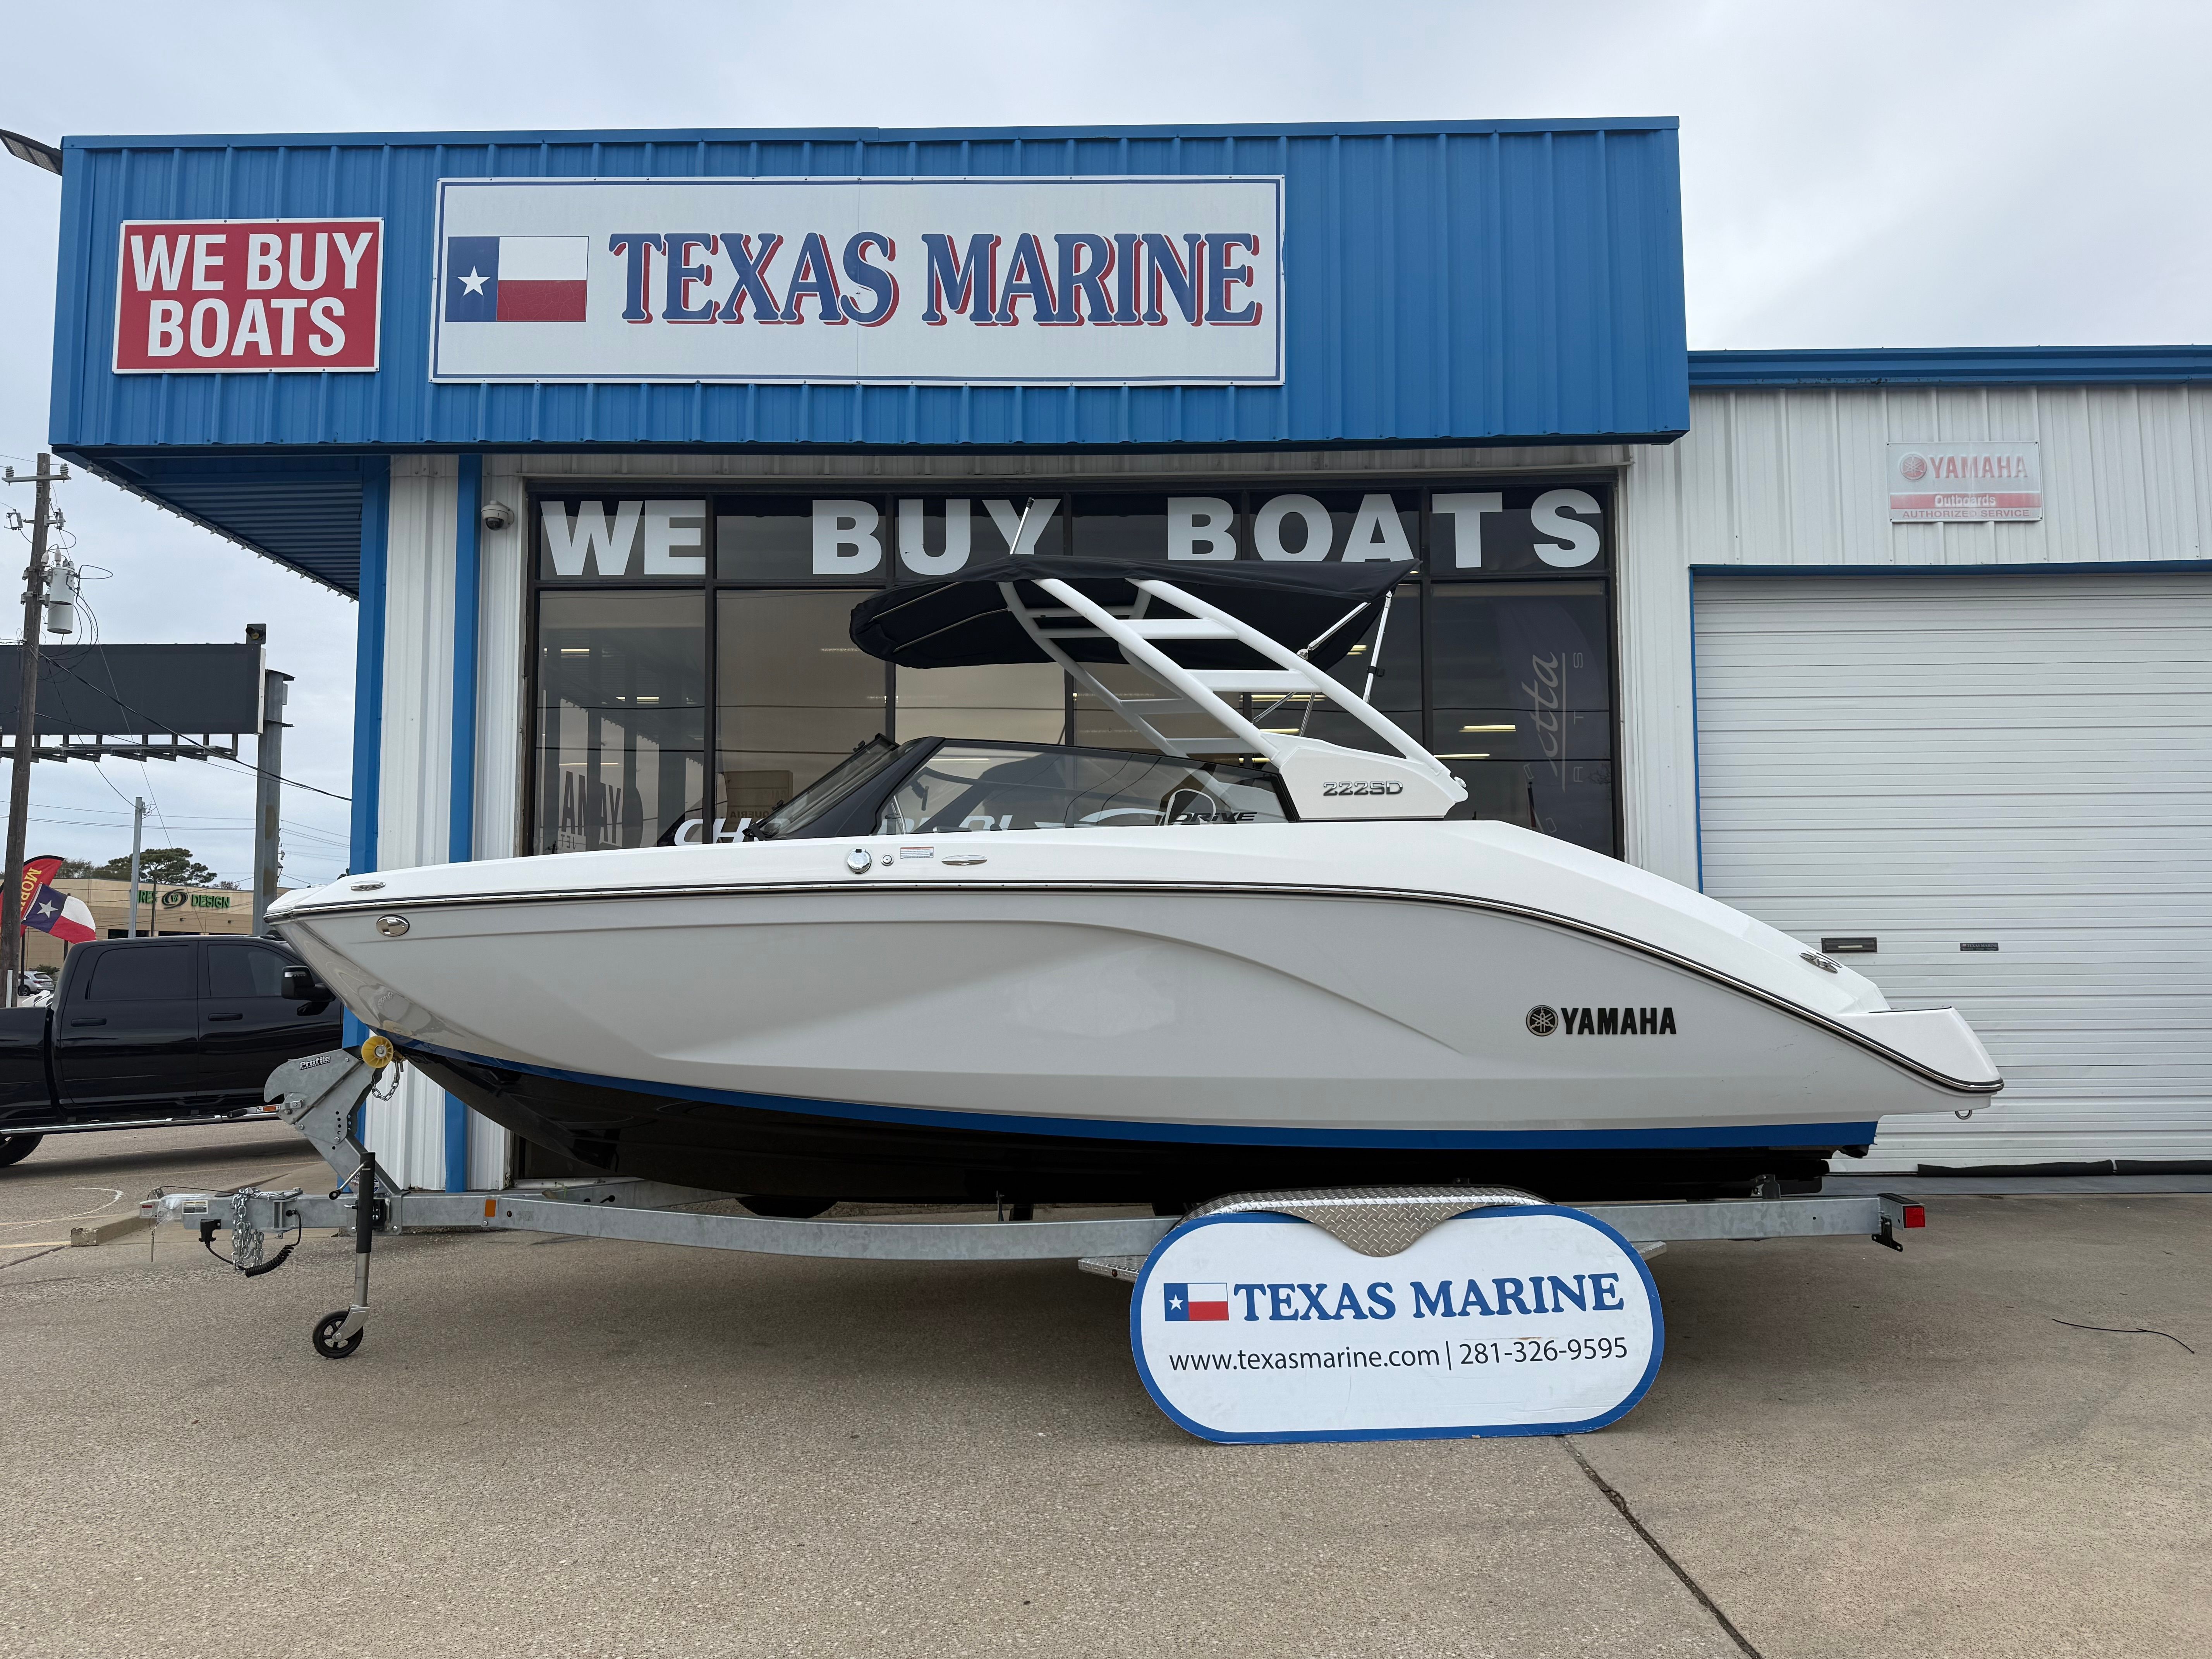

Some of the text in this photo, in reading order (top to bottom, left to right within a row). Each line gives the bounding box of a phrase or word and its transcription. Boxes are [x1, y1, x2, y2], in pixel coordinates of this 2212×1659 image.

[130, 232, 373, 291] WE BUY
[608, 232, 1262, 326] TEXAS MARINE
[147, 297, 345, 357] BOATS
[1929, 455, 2028, 479] YAMAHA
[1903, 510, 1977, 518] AUTHORIZED
[1934, 495, 1996, 508] Outboards
[540, 489, 1601, 575] WE BUY BOATS
[1323, 780, 1403, 796] 222SD
[191, 894, 230, 908] DESIGN
[1561, 1007, 1676, 1034] YAMAHA
[300, 1056, 330, 1068] Profile
[1233, 1272, 1625, 1321] TEXAS MARINE
[1170, 1337, 1628, 1371] www.texasmarine.com 281-326-9595
